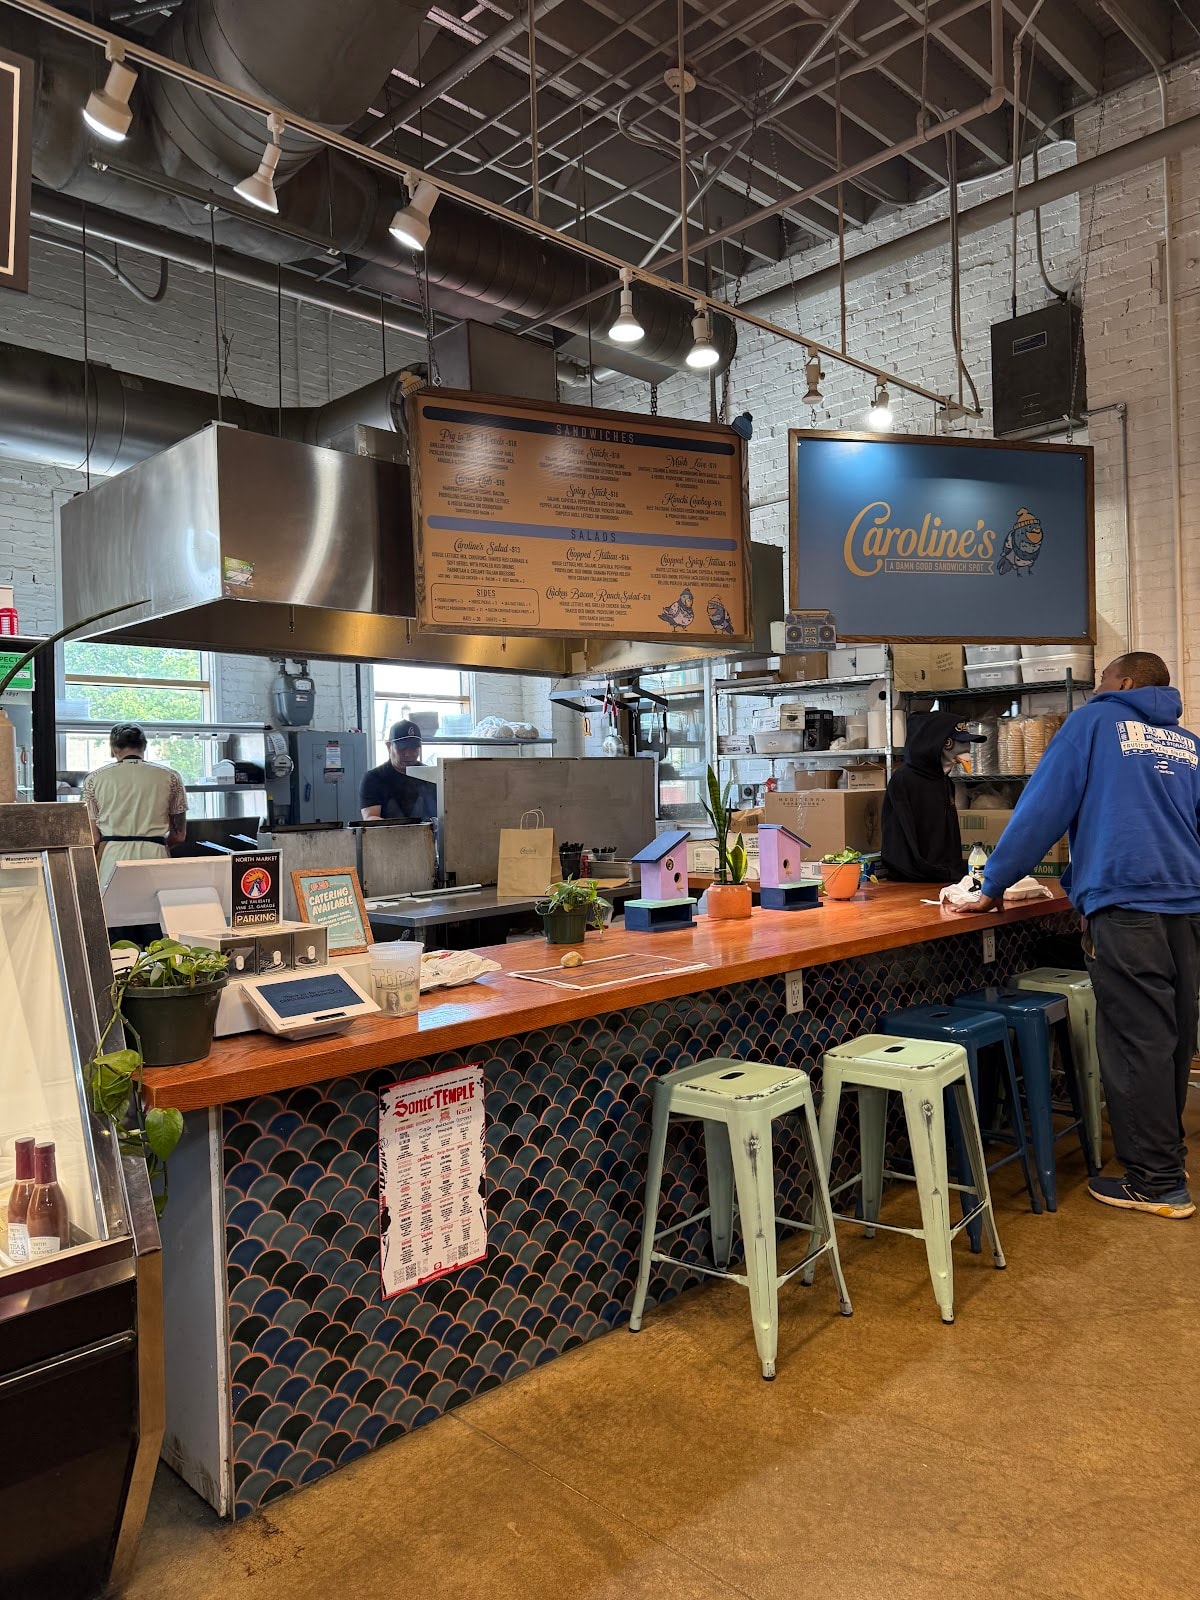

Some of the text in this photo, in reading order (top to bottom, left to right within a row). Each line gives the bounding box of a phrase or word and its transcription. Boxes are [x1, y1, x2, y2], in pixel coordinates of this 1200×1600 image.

[556, 425, 634, 443] SANDWICHES
[567, 484, 585, 497] Spicy
[571, 530, 616, 542] SALADS
[844, 501, 996, 576] Caroline's
[454, 538, 484, 553] Caroline's
[487, 542, 508, 555] Salad
[567, 547, 591, 560] Chopped
[660, 553, 683, 567] Chopped
[686, 556, 703, 568] Spicy
[889, 562, 984, 572] A DAMN GOOD SANDWICH SPOT
[571, 588, 593, 599] Bacon
[309, 887, 348, 906] CATERING
[312, 895, 353, 915] AVAILABLE
[237, 913, 275, 923] PARKING
[434, 1081, 474, 1108] TEMPLE
